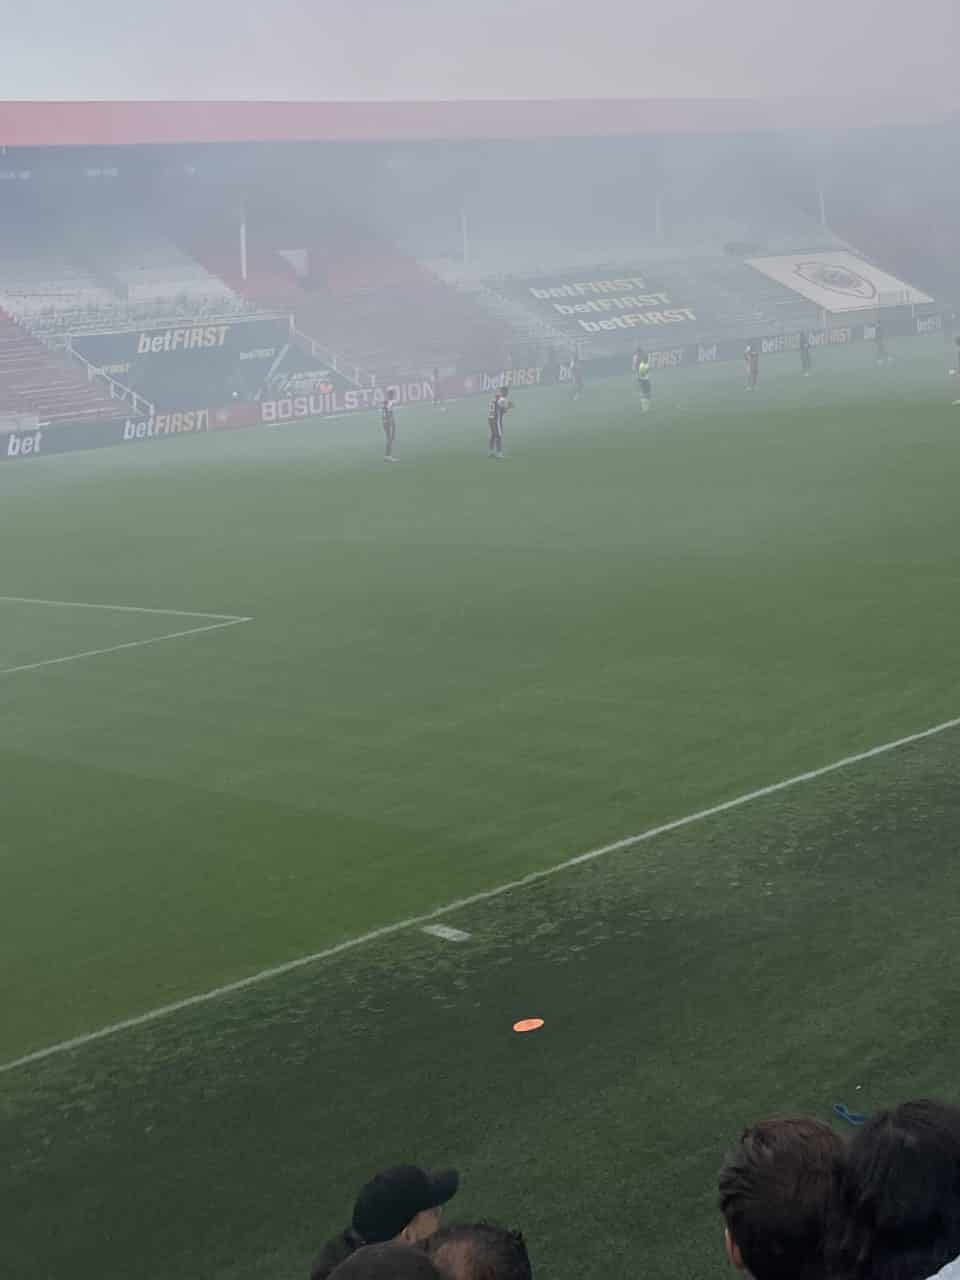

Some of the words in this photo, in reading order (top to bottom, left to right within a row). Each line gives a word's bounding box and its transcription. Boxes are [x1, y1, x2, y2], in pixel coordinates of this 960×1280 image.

[529, 277, 647, 299] betFIRST
[553, 292, 672, 315] betFIRST
[577, 307, 697, 332] betFIRST
[136, 326, 230, 354] betFIRST
[123, 409, 208, 440] betFIRST
[7, 431, 42, 456] bet
